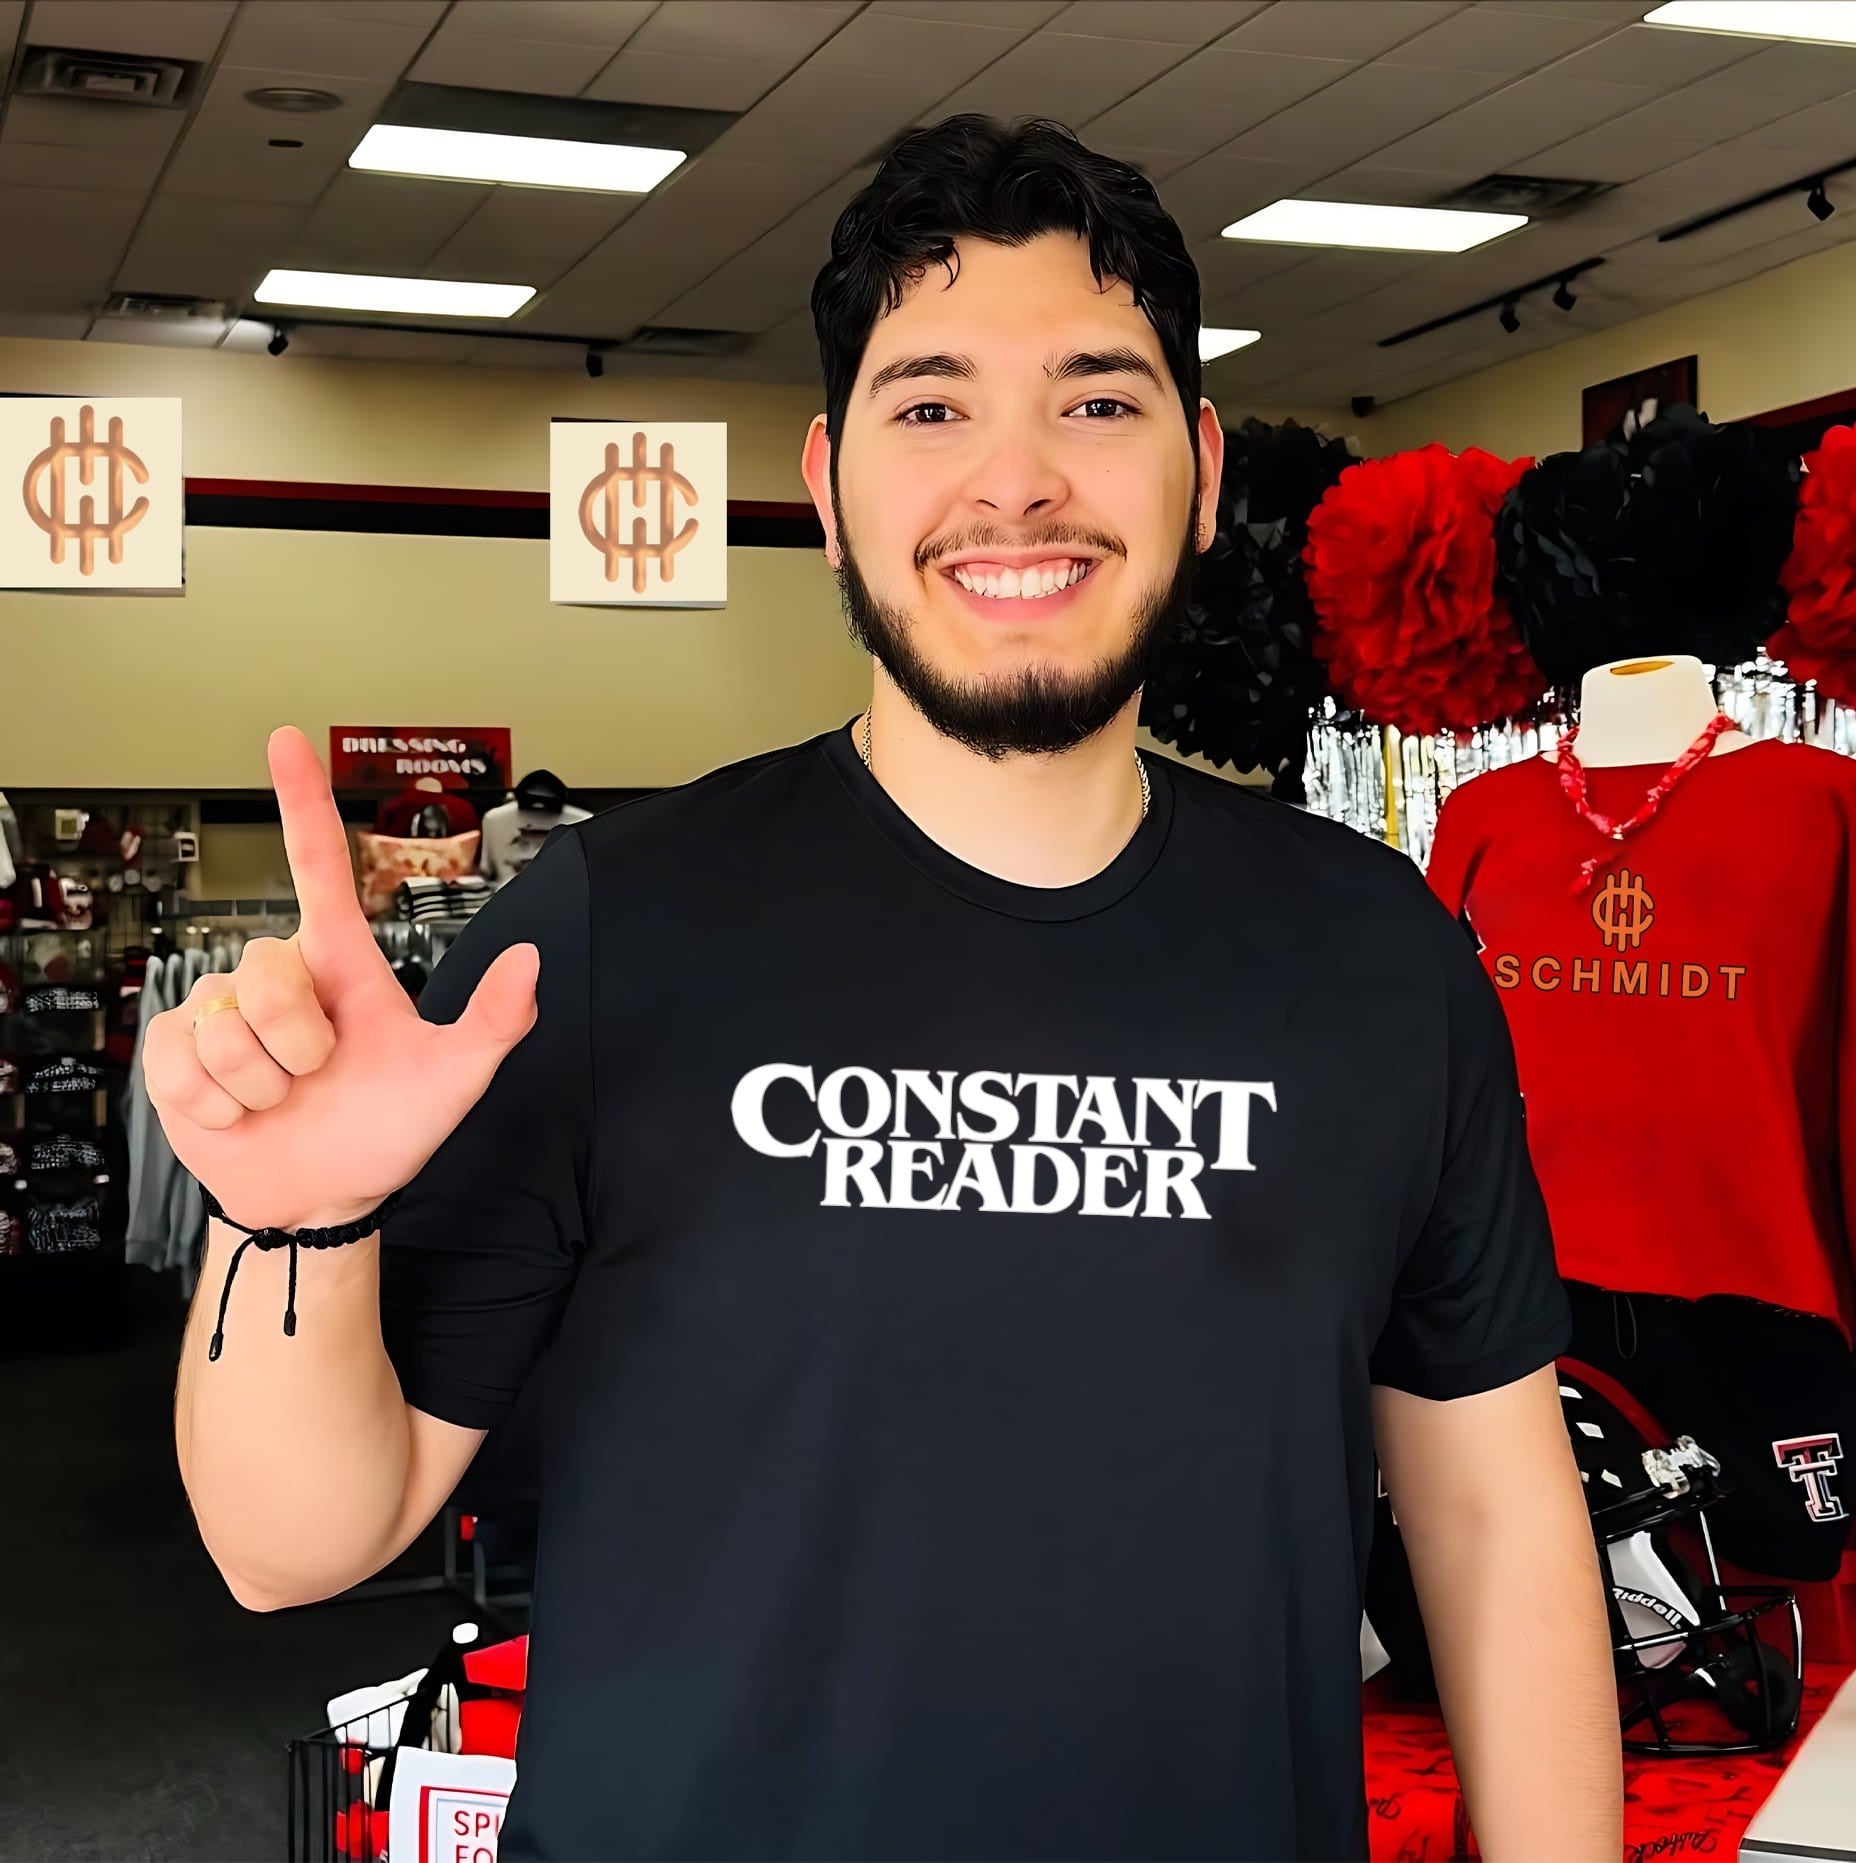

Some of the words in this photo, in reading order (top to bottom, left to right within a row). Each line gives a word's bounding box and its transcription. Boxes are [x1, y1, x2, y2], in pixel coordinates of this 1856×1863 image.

[396, 758, 487, 775] ROOMS
[1494, 953, 1746, 1001] SCHMIDT
[730, 1062, 1278, 1171] CONSTANT
[819, 1137, 1213, 1220] READER
